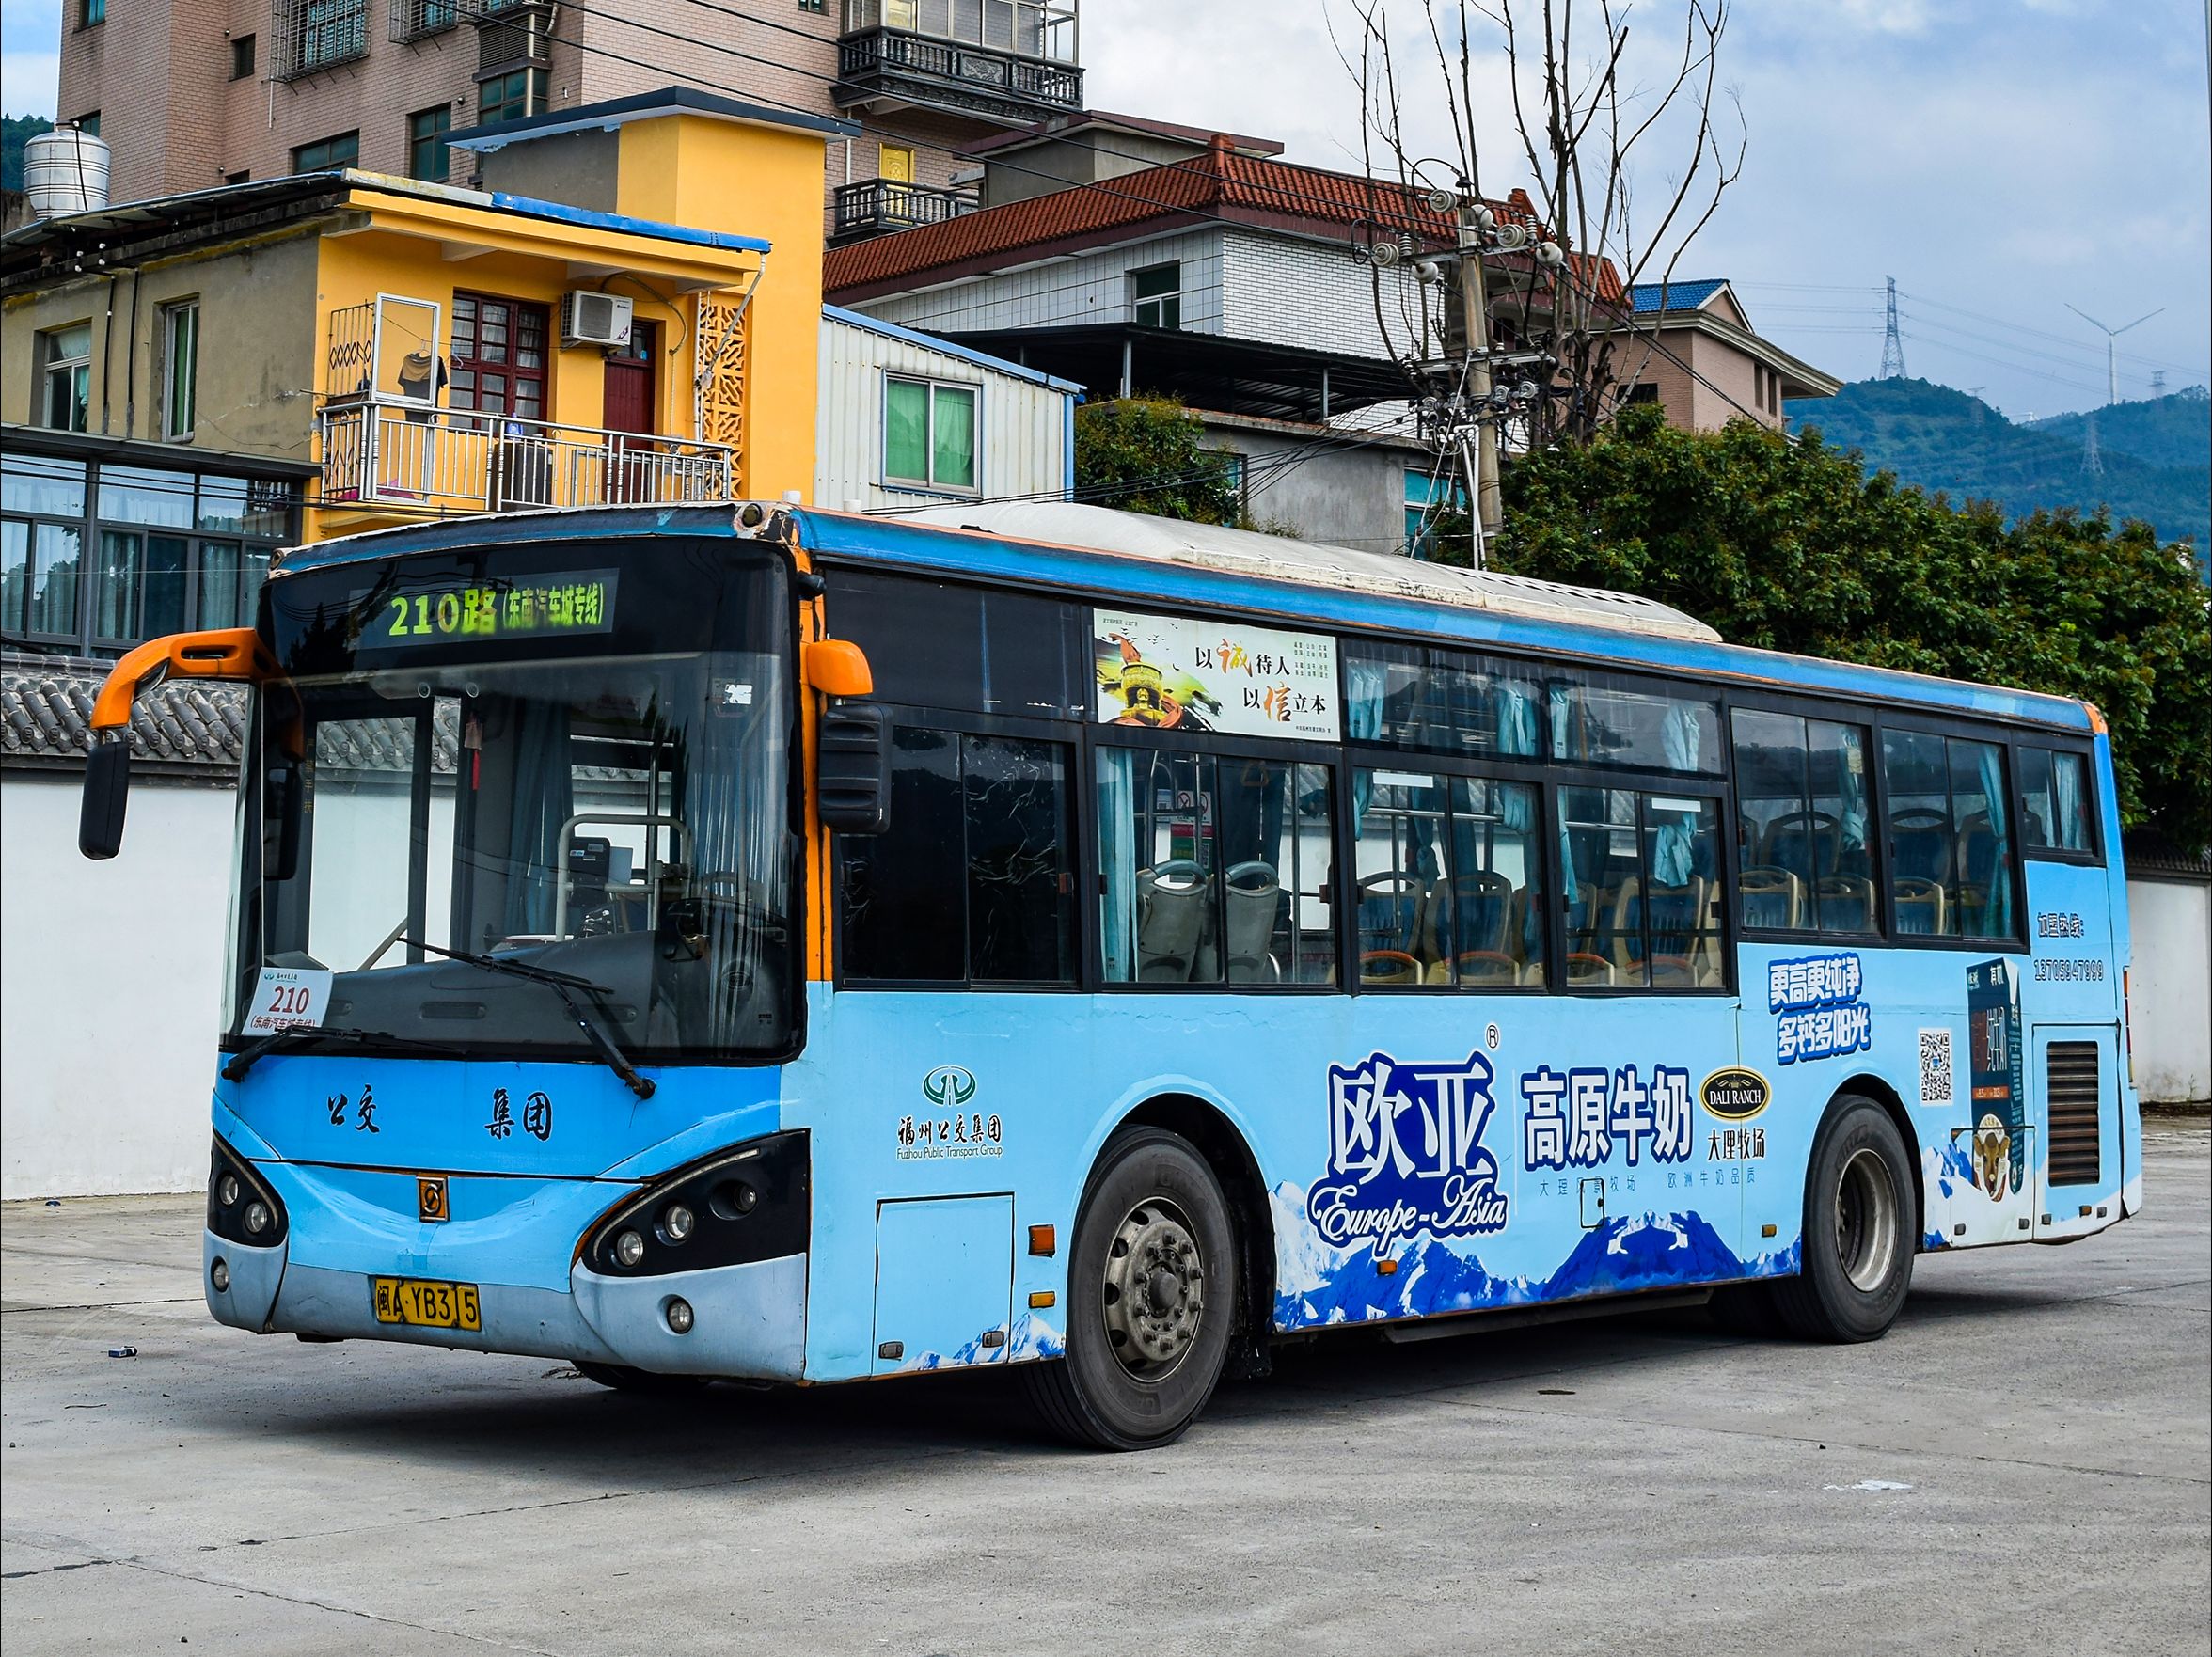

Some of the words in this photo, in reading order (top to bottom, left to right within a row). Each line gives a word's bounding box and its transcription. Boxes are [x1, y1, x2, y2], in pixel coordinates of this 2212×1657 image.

[1194, 639, 1290, 678] 以诚待人
[1242, 681, 1326, 722] 以信立本
[1769, 955, 1861, 1007] 更高更纯净
[2033, 958, 2104, 982] 13705947999
[268, 986, 310, 1015] 210
[1778, 1005, 1870, 1058] 多钙多阳光
[328, 1083, 380, 1134] 公交
[484, 1088, 553, 1143] 集团
[1522, 1066, 1694, 1168] 高原牛奶
[1709, 1090, 1730, 1106] DALI
[1731, 1089, 1762, 1105] RANCH
[898, 1113, 1002, 1146] 福州公交集团
[1330, 1057, 1495, 1186] 欧亚
[896, 1147, 923, 1160] Fuzhou
[924, 1146, 944, 1159] Public
[945, 1145, 979, 1160] Transport
[980, 1144, 1003, 1159] Group
[1707, 1128, 1766, 1161] 大理牧场
[1310, 1174, 1507, 1253] Europe-Asia
